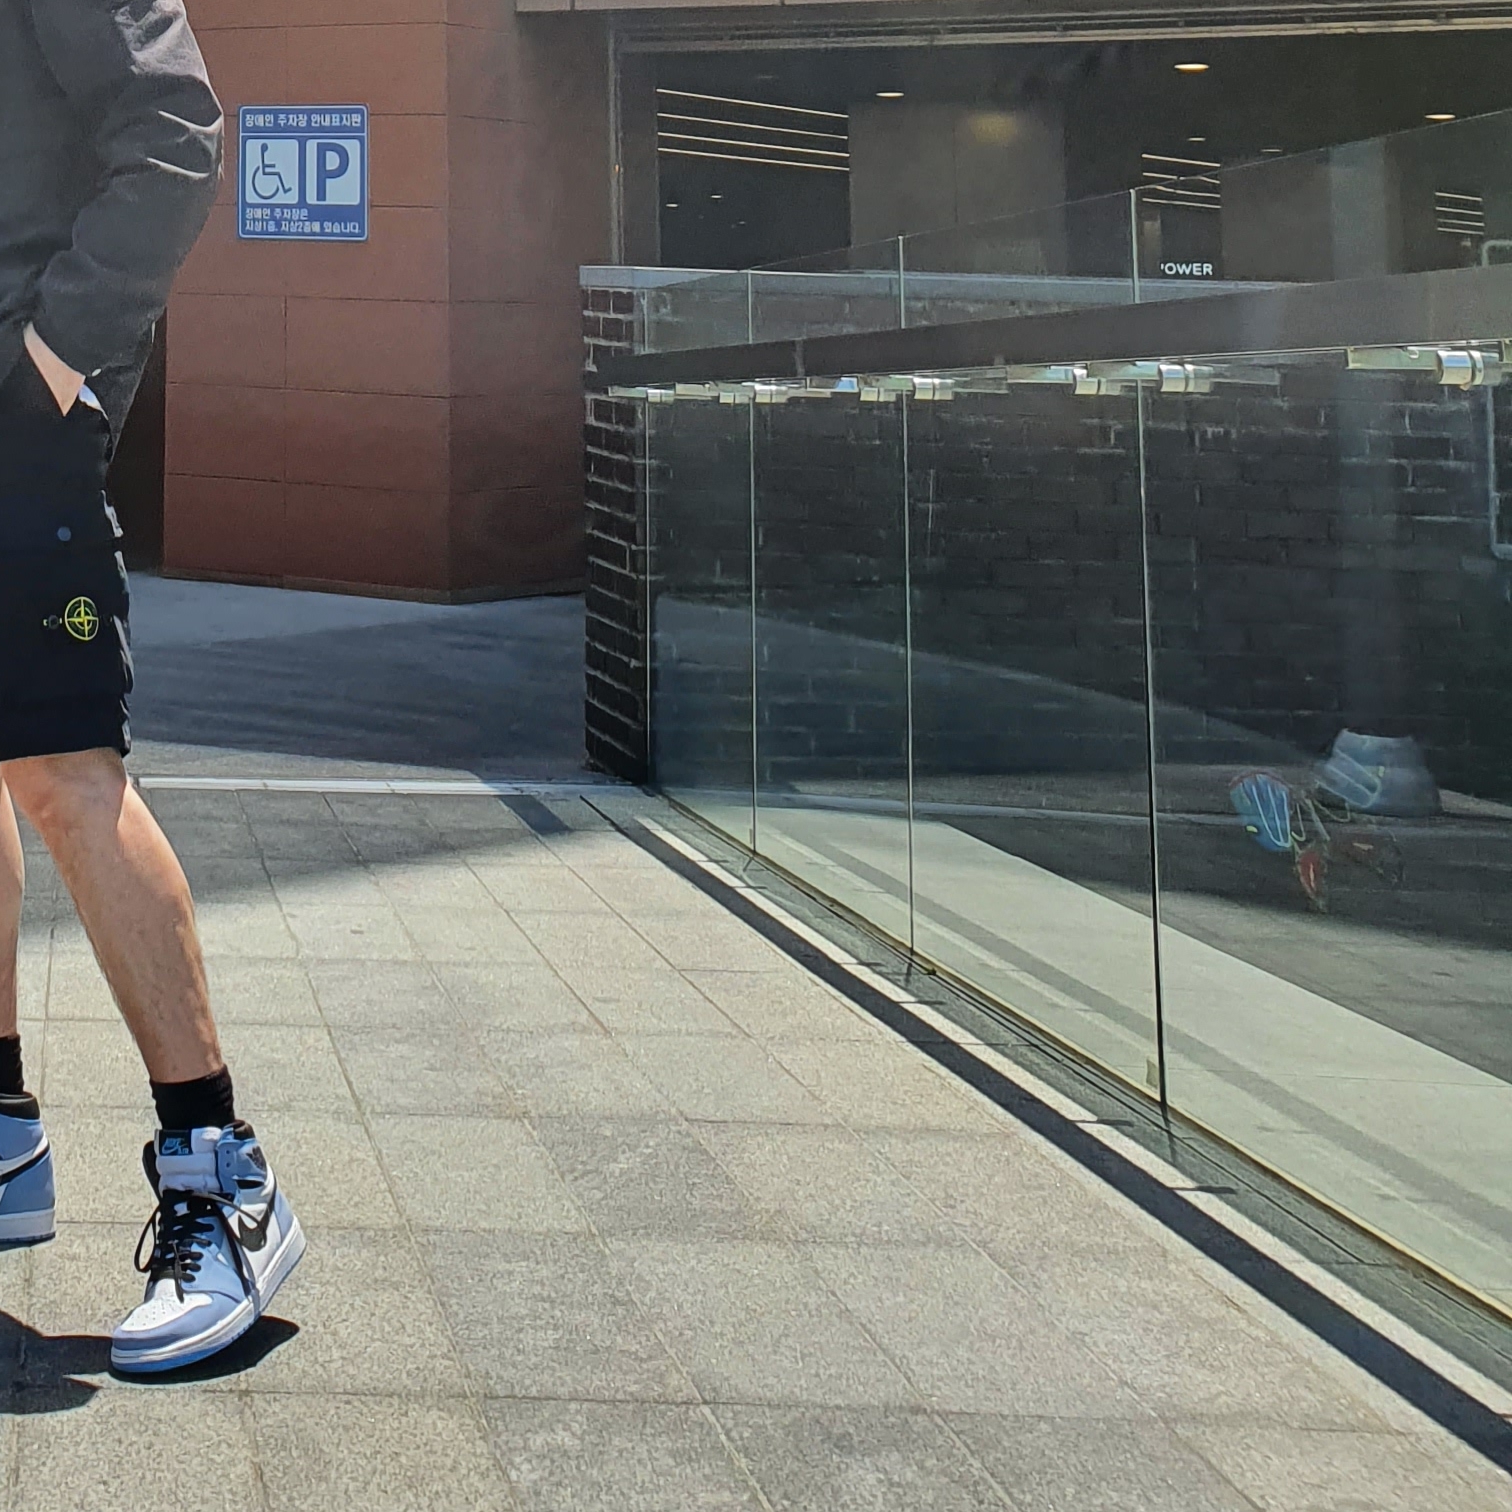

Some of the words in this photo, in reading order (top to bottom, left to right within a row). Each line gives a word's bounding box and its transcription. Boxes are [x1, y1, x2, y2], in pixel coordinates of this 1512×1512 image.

[245, 114, 274, 127] 장애인
[278, 114, 307, 127] 주차장
[311, 113, 361, 127] 안내표지판
[316, 142, 349, 202] P
